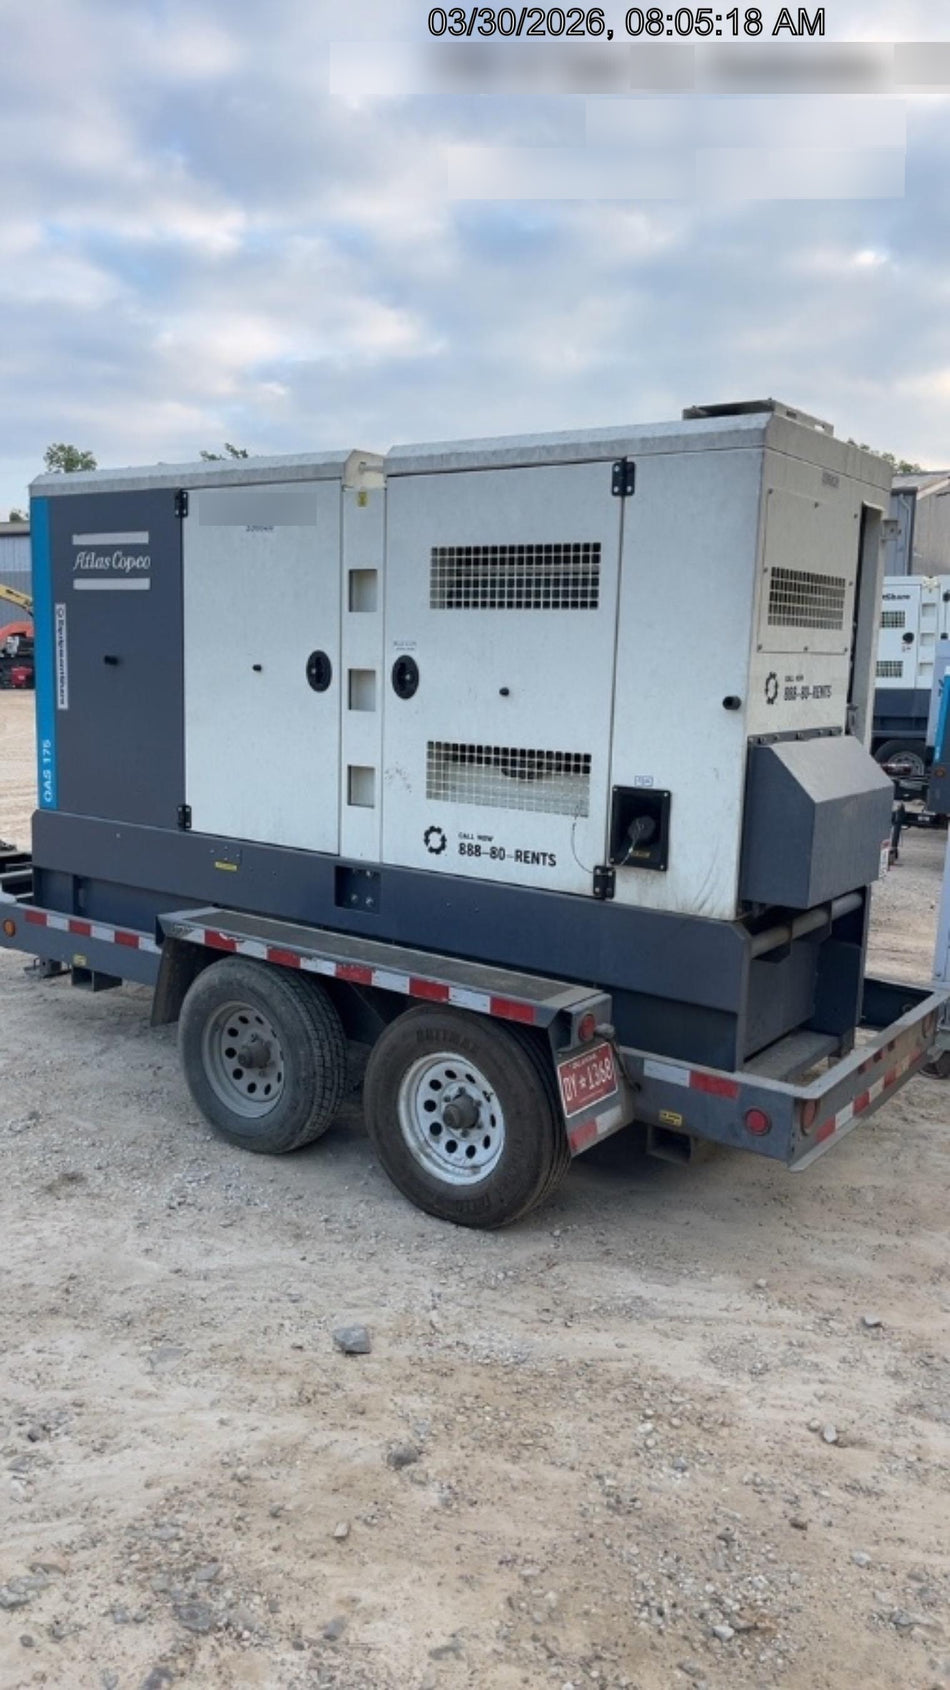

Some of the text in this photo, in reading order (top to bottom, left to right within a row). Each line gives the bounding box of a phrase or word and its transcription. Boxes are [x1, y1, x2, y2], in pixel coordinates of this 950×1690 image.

[73, 550, 151, 573] Atlas Copco
[458, 832, 474, 840] CALL
[458, 842, 557, 868] 888-80-RENTS
